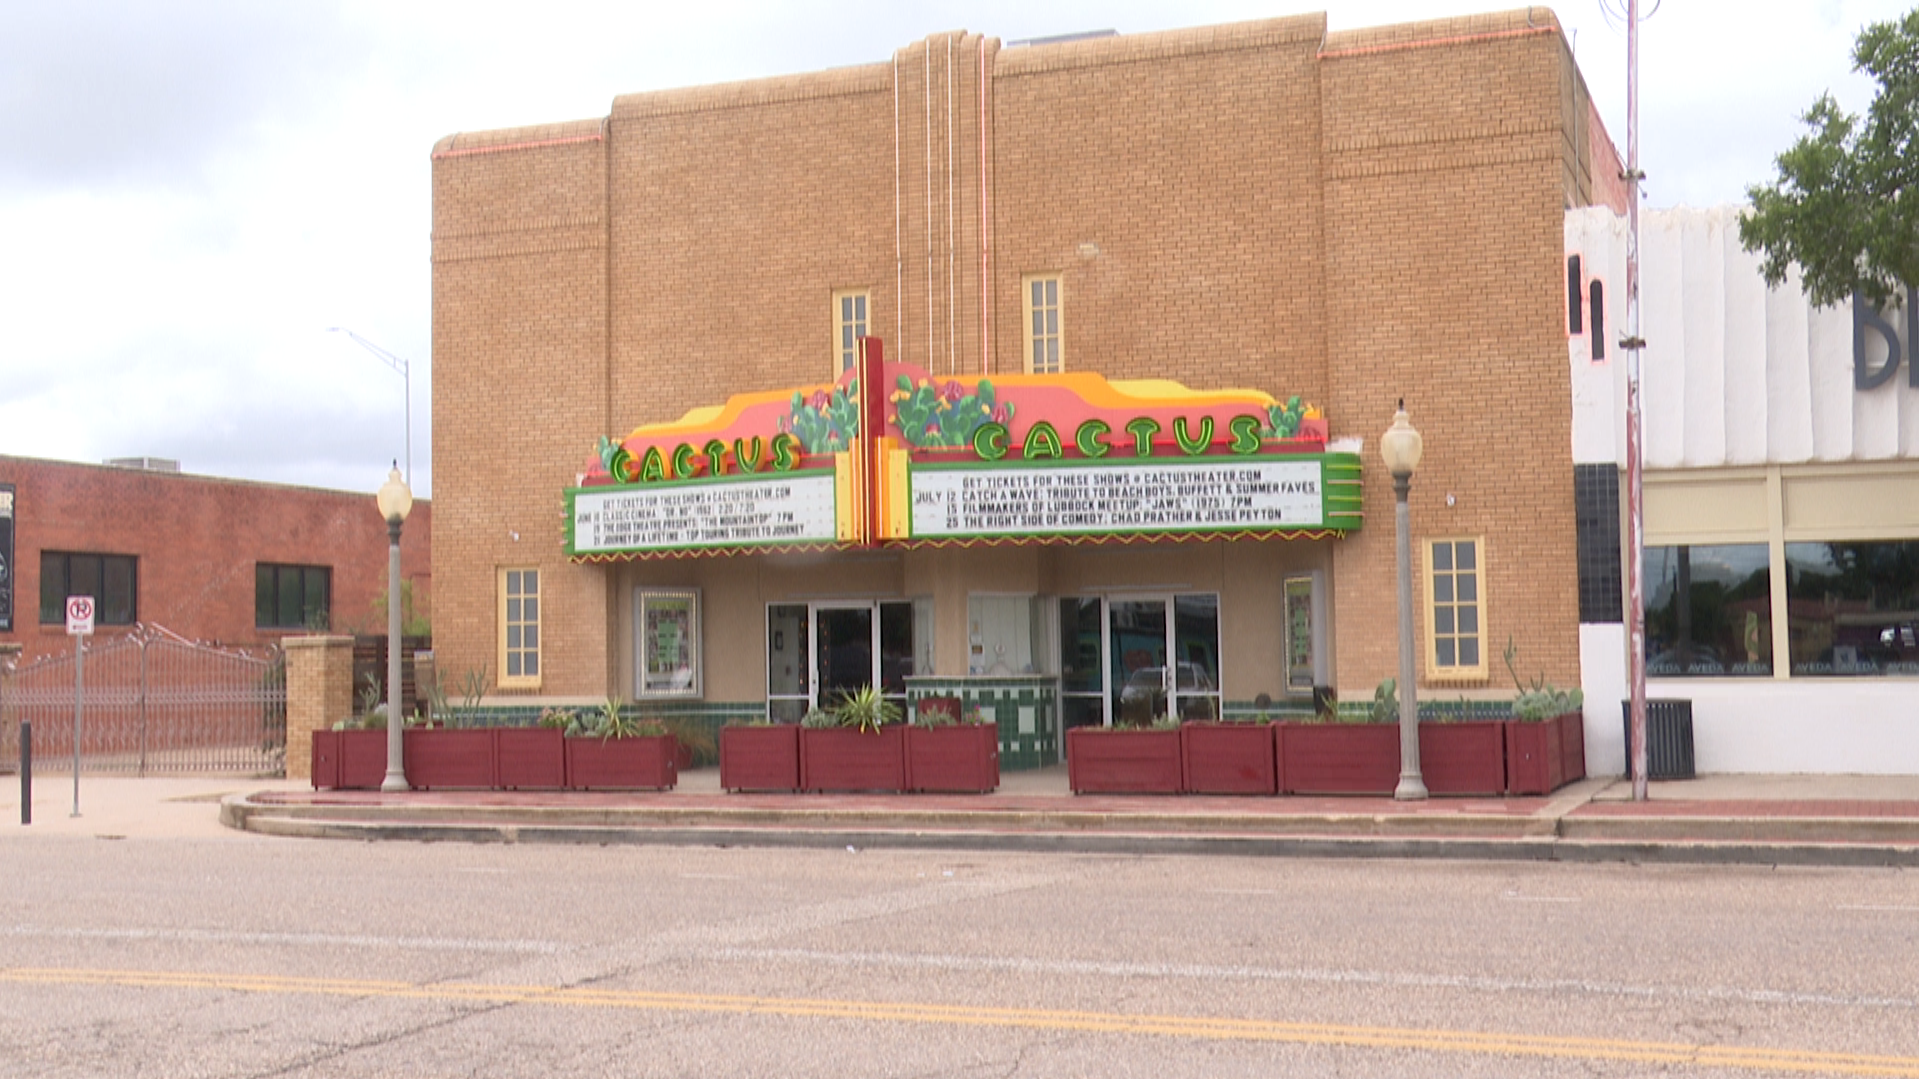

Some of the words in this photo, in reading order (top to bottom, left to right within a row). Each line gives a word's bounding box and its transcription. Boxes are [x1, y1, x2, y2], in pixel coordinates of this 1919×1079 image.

[973, 415, 1263, 461] CACTUS
[610, 432, 803, 484] CACTUS
[963, 477, 983, 489] GET
[986, 475, 1030, 488] TICKETS
[1033, 475, 1053, 486] FOR
[1056, 475, 1090, 486] THESE
[1094, 473, 1130, 485] SHOWS
[1144, 470, 1262, 484] CACTUSTHEATER.COM
[603, 499, 616, 510] GET
[617, 497, 644, 509] TICKETS
[645, 496, 658, 507] FOR
[660, 494, 681, 505] THESE
[682, 492, 706, 504] SHOWS
[713, 487, 792, 502] CACTUSTHEATER.COM
[916, 491, 942, 504] JULY
[946, 491, 956, 502] 12
[962, 490, 997, 501] CATCH
[1000, 490, 1007, 500] A
[1047, 487, 1089, 499] TRIBUTE
[1092, 487, 1106, 498] TO
[1108, 487, 1143, 498] BEACH
[1178, 483, 1221, 496] BUFFETT
[1226, 484, 1233, 494] &
[1236, 482, 1280, 494] SUMMER
[1281, 481, 1314, 493] FAVES
[577, 513, 592, 523] JUNE
[603, 509, 630, 521] CLASSIC
[946, 503, 957, 516] 15
[962, 502, 1029, 515] FILMMAKERS
[1032, 502, 1043, 512] OF
[1047, 500, 1096, 512] LUBBOCK
[1145, 497, 1187, 510] "JAWS"
[1191, 497, 1225, 509] (1975)
[603, 522, 615, 534] THE
[616, 521, 632, 532] EDGE
[633, 520, 662, 531] THEATRE
[946, 516, 958, 528] 25
[964, 516, 984, 528] THE
[986, 515, 1018, 527] RIGHT
[1020, 514, 1044, 526] SIDE
[1046, 514, 1059, 525] OF
[1111, 511, 1141, 524] CHAD
[1143, 510, 1193, 523] PRATHER
[1195, 511, 1202, 522] &
[1205, 510, 1237, 521] JESSE
[1239, 508, 1282, 521] PEYTON
[604, 534, 631, 546] JOURNEY
[632, 534, 640, 544] OF
[648, 531, 679, 543] LIFETIME
[686, 529, 700, 542] TOP
[701, 527, 730, 540] TOURING
[731, 526, 760, 538] TRIBUTE
[761, 525, 771, 537] TO
[772, 523, 804, 536] JOURNEY
[1646, 662, 1681, 673] AVEDA
[1688, 662, 1724, 673] AVEDA
[1731, 662, 1768, 673] AVEDA
[1794, 662, 1832, 673] AVEDA
[1840, 661, 1878, 673] AVEDA
